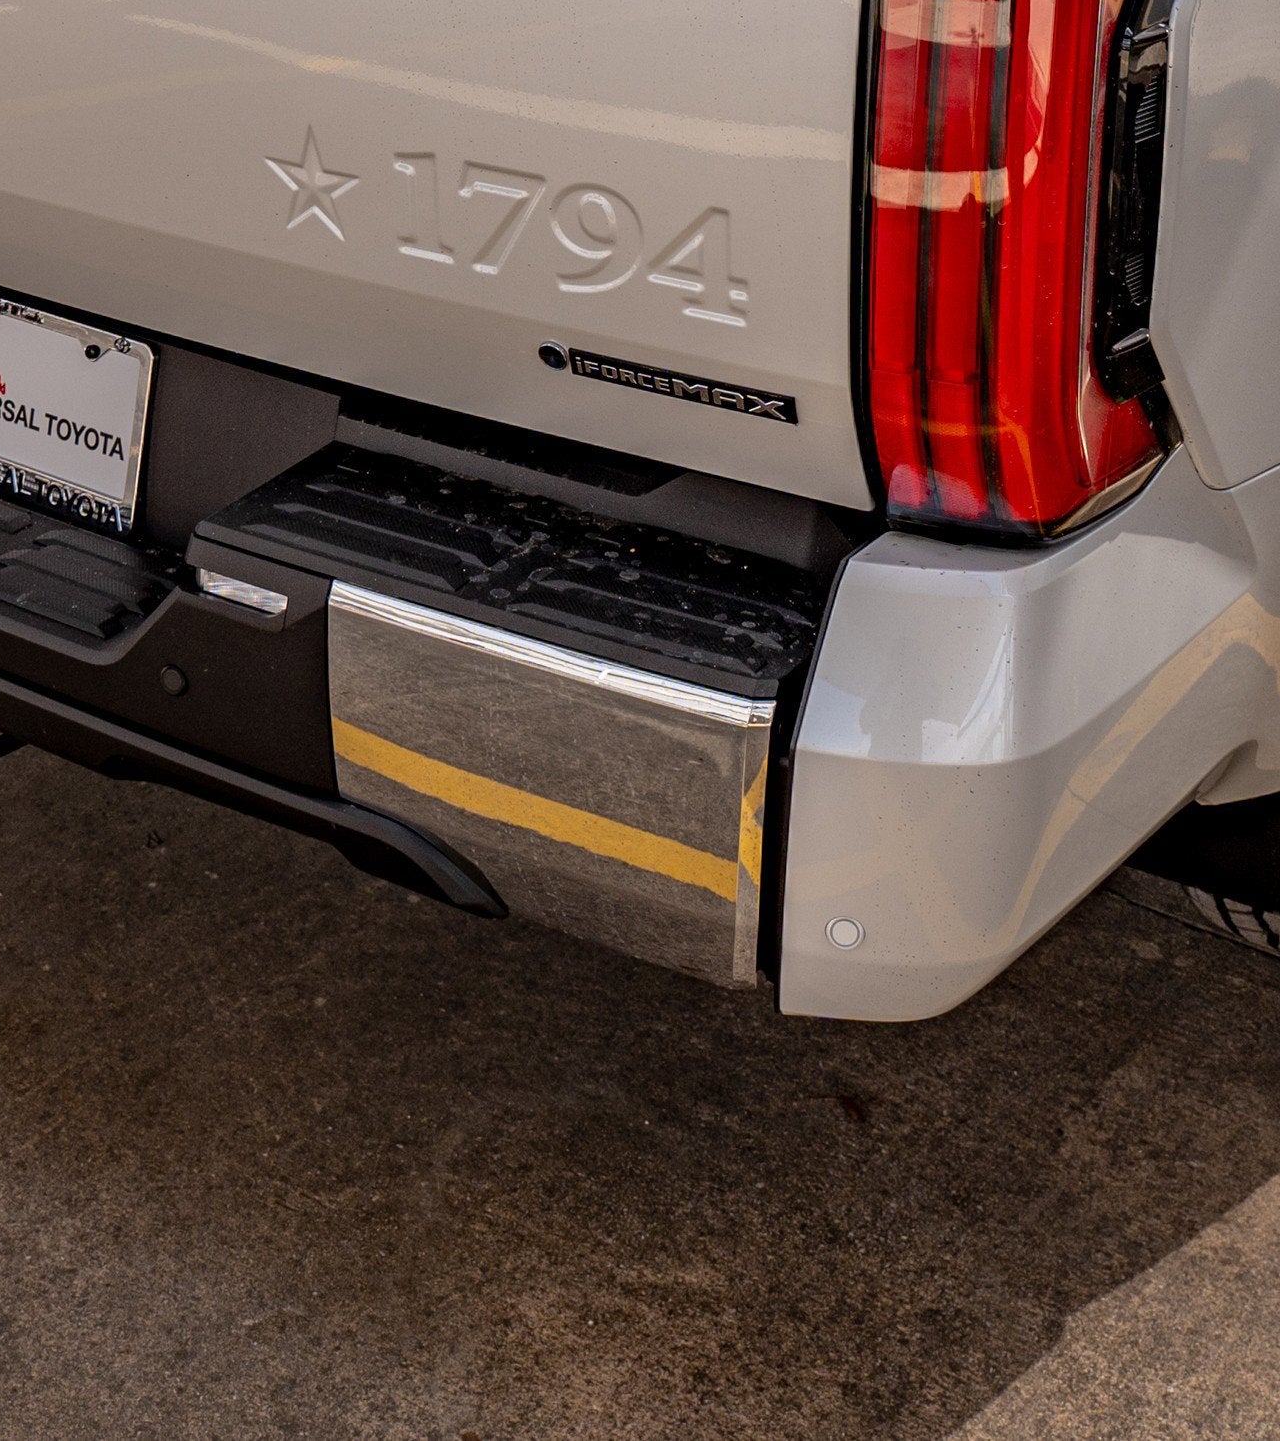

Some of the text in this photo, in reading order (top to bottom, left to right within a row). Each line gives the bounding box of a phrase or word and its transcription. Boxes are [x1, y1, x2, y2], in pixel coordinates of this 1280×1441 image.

[394, 152, 749, 328] 1794
[45, 413, 124, 461] TOYOTA
[34, 475, 123, 533] TOYOTA
